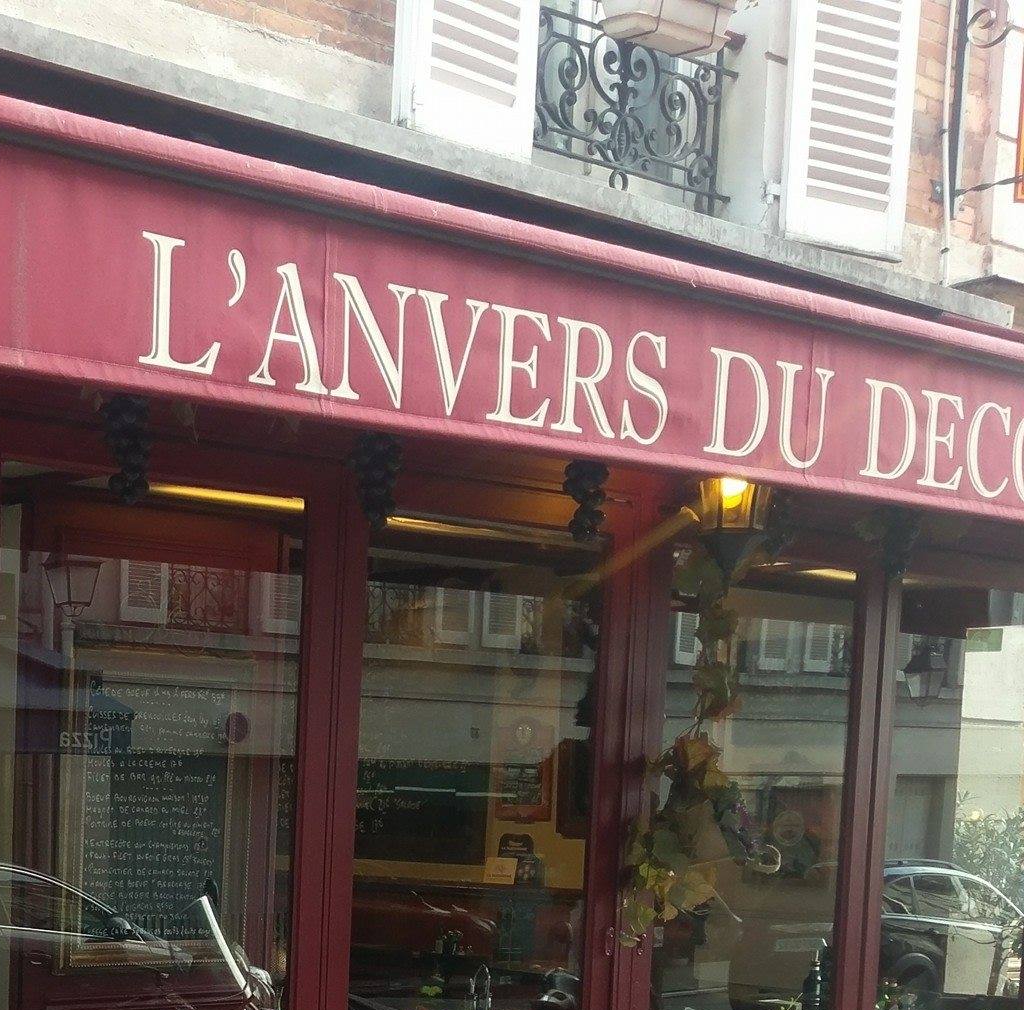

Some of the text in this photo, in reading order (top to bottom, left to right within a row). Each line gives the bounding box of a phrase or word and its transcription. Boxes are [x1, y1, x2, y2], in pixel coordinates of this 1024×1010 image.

[138, 229, 1024, 502] L'ANVERS DU DEC
